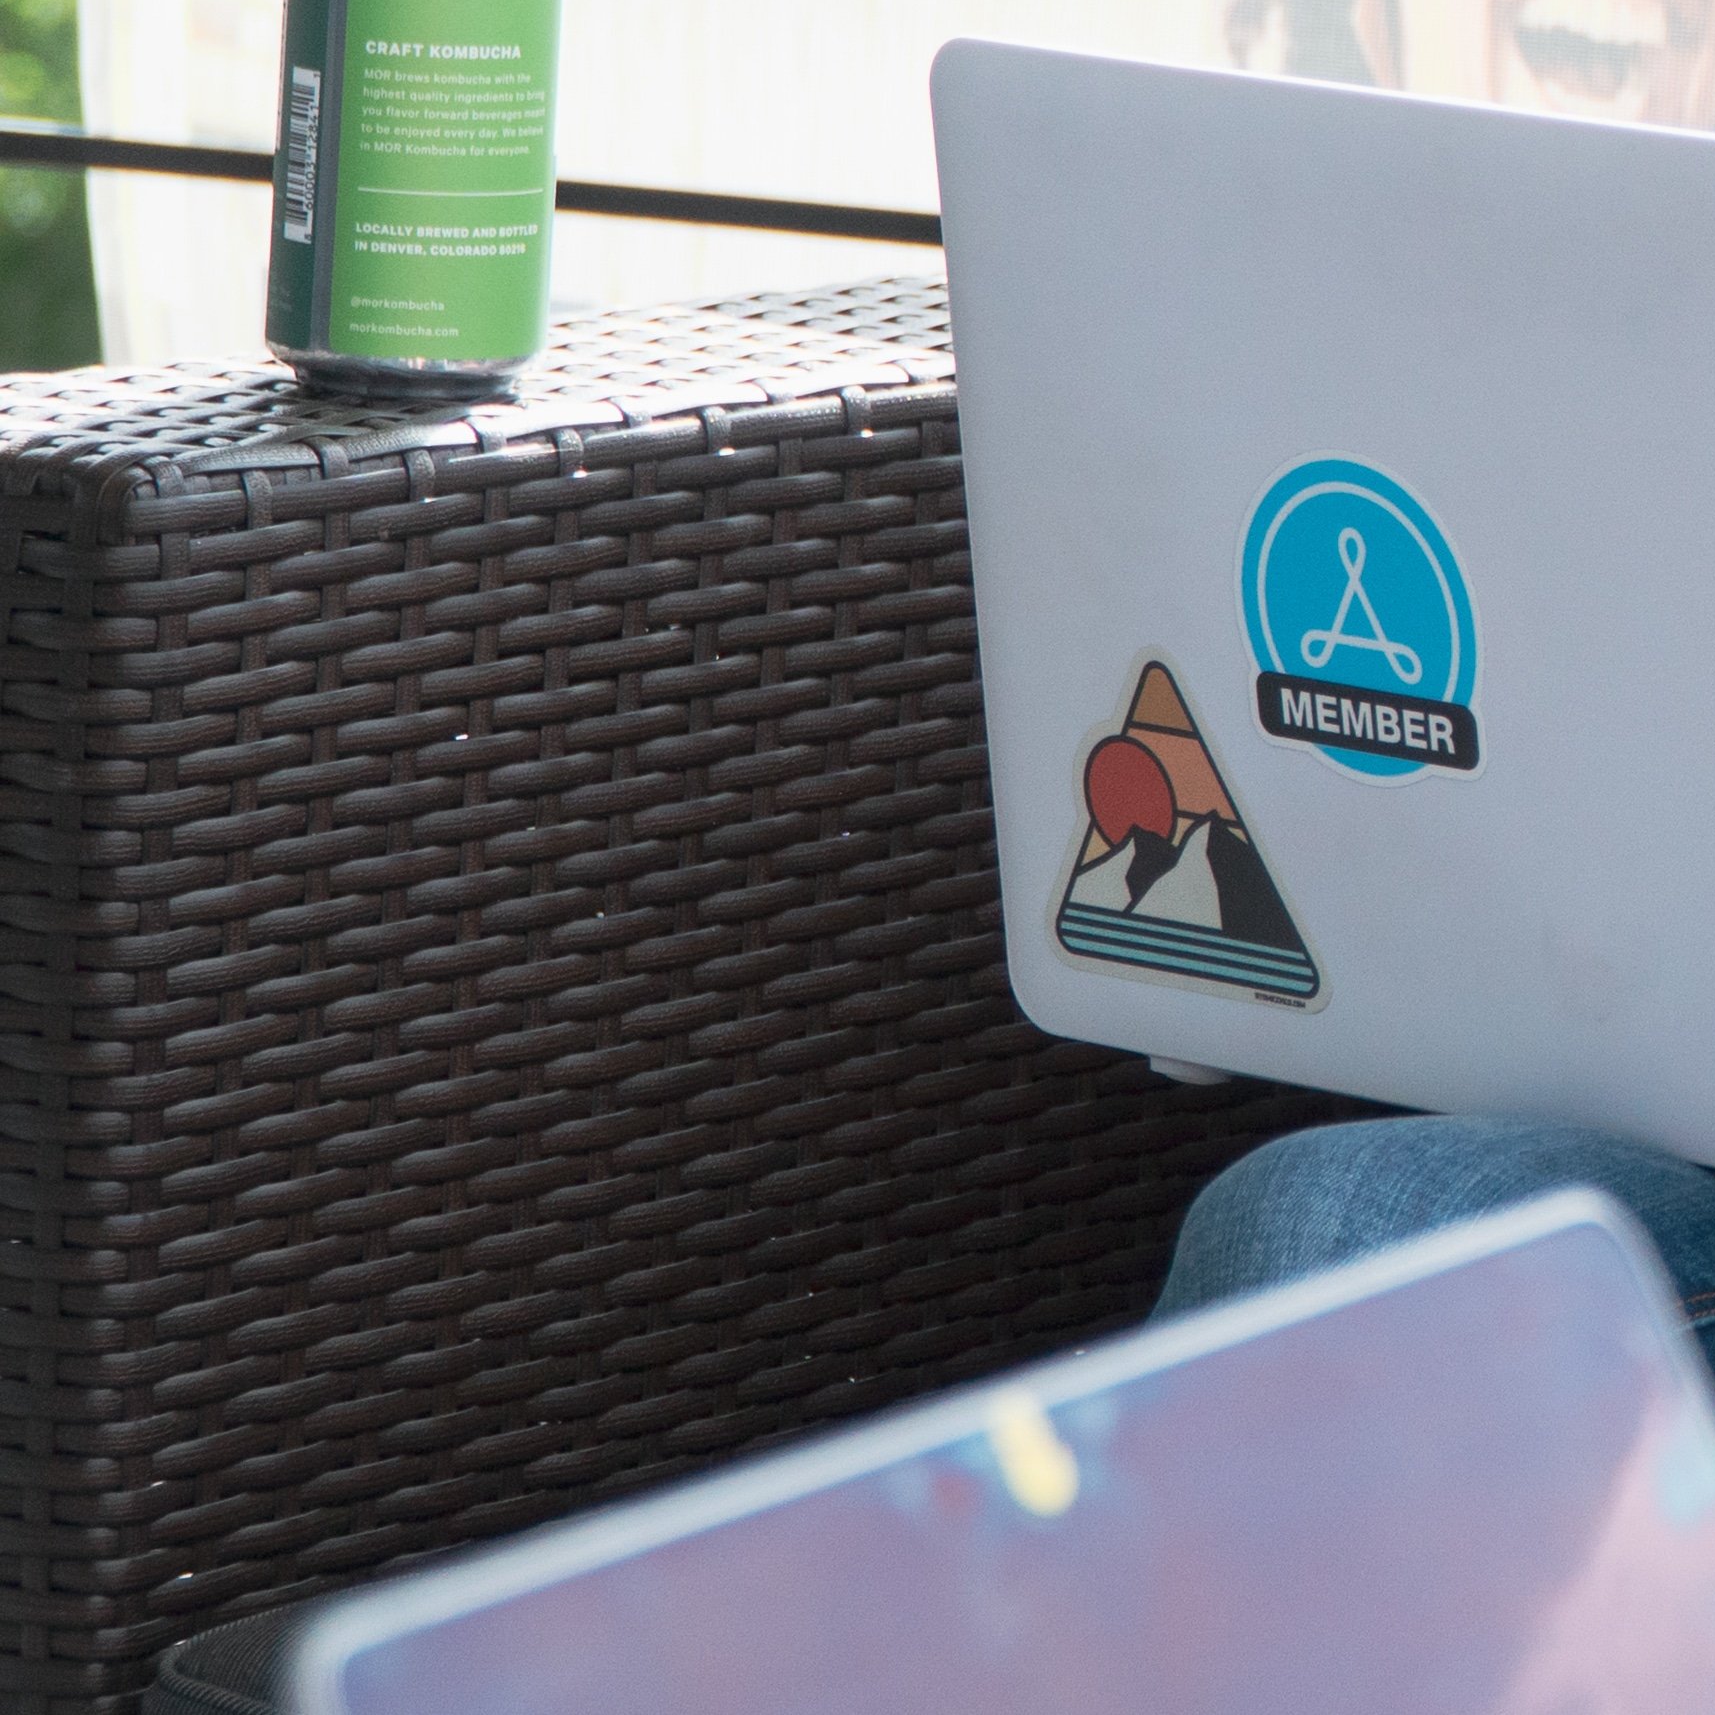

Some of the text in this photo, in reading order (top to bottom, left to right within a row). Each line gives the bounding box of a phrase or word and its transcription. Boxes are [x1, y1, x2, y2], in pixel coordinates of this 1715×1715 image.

[366, 41, 521, 60] CRAFT KOMBUCHA
[364, 69, 531, 84] MOR brews kombucha with the
[363, 87, 545, 103] highest quality ingredients to bring
[362, 107, 545, 121] you flavor forward beverages meant
[307, 105, 318, 151] 12841
[361, 123, 372, 133] to
[376, 124, 390, 134] be
[394, 126, 440, 138] enjoyed
[444, 129, 475, 139] every
[502, 128, 516, 137] We
[518, 126, 544, 136] believe
[374, 143, 402, 153] MOR
[406, 144, 466, 156] Kombucha
[470, 145, 486, 155] for
[304, 162, 314, 210] 60003
[355, 223, 538, 238] LOCALLY BREWED AND BOTTLED
[354, 241, 526, 256] IN DENVER, COLORADO 80216
[350, 296, 445, 311] @morkombucha
[349, 323, 459, 337] morkombucha.com
[1280, 688, 1456, 754] MEMBER
